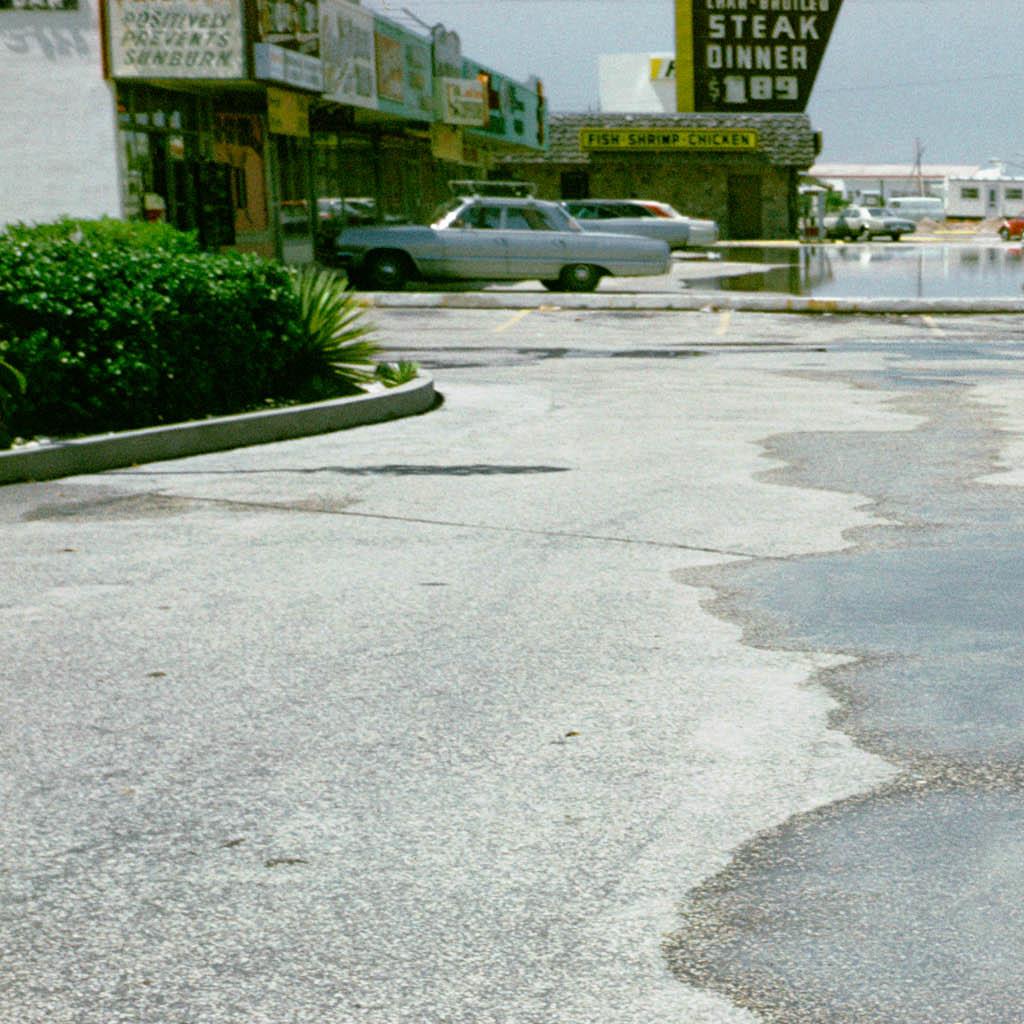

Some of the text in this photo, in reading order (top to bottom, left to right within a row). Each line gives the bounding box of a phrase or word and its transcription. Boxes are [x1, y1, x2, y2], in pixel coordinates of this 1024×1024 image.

[121, 11, 231, 29] POSITIVELY
[708, 14, 820, 40] STEAK
[120, 30, 231, 48] PREVENTS
[124, 49, 232, 67] SUNBURN
[706, 44, 807, 70] DINNER
[588, 133, 750, 146] FISH SHRIMP CHICKEN
